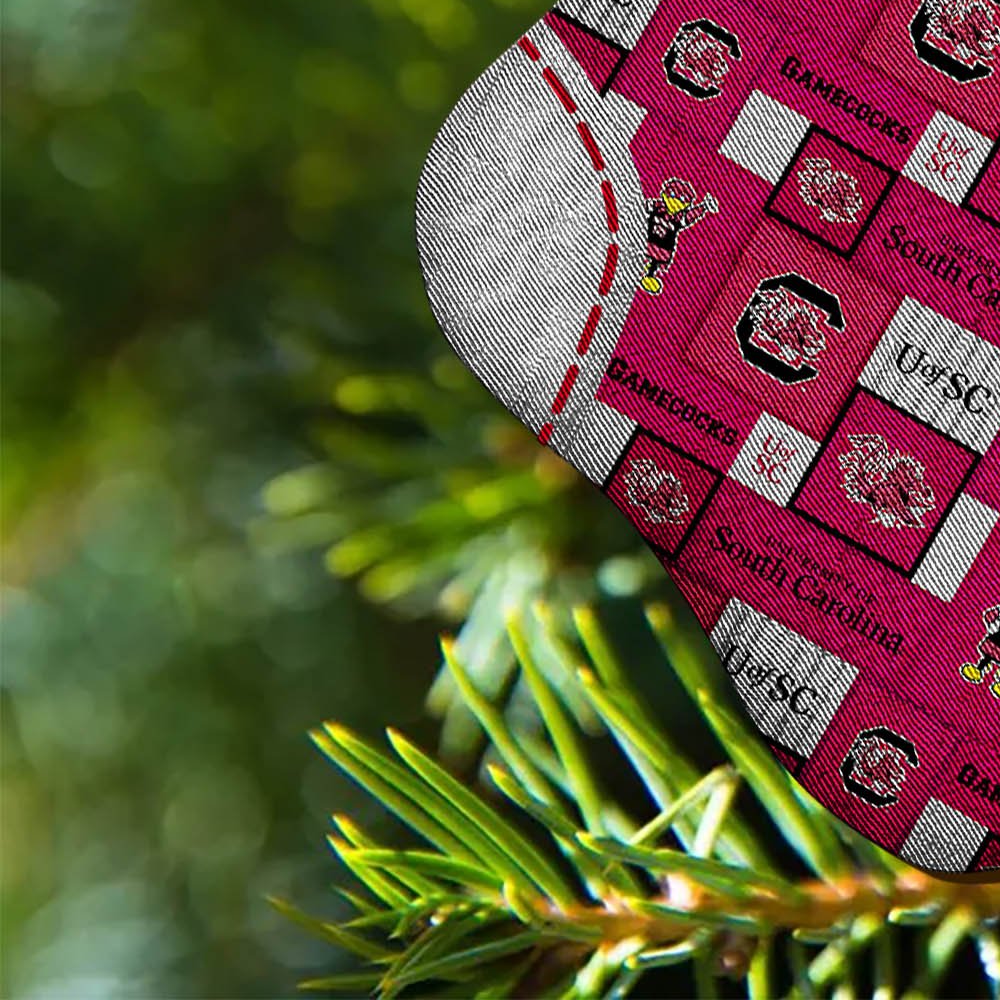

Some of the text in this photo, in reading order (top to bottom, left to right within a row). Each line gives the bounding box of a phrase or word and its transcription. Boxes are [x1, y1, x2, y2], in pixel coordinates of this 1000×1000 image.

[780, 55, 913, 145] GAMECOCKS
[883, 224, 962, 286] South
[606, 357, 739, 447] GAMECOCKS
[711, 525, 904, 655] South Carolina
